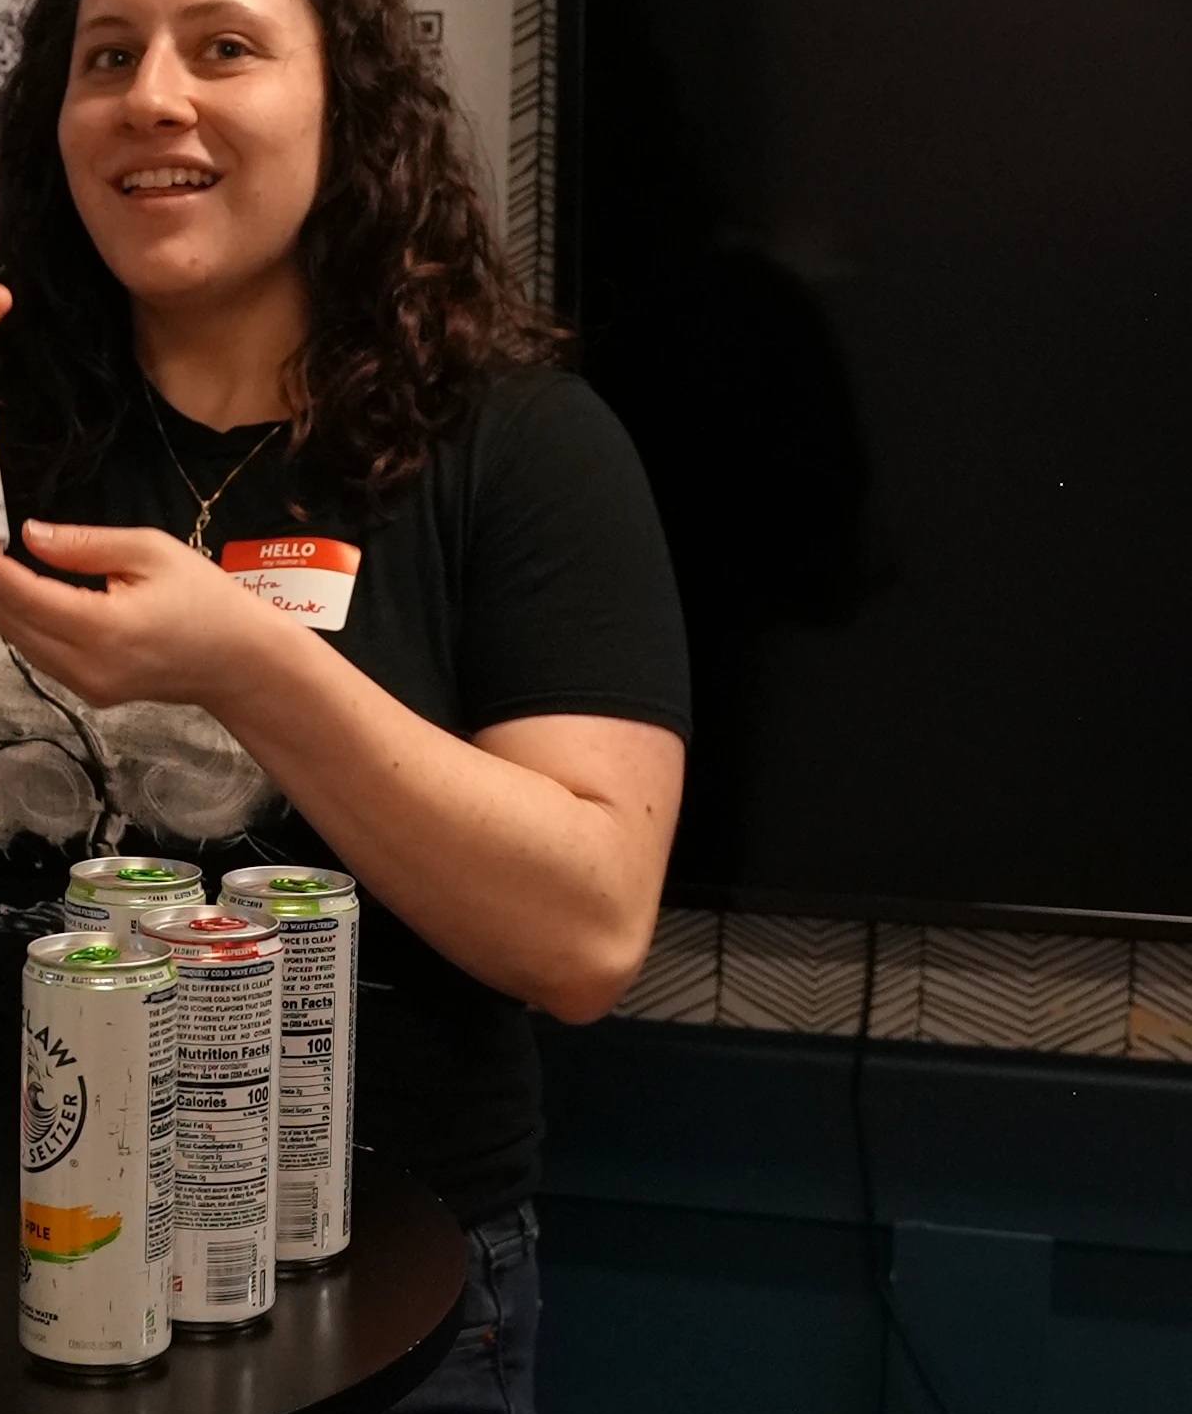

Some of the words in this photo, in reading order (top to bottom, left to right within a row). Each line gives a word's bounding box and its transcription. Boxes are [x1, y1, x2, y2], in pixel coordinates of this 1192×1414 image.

[260, 542, 316, 559] HELLO
[303, 936, 309, 944] IS
[192, 983, 241, 992] DIFFERENCE
[301, 996, 333, 1009] Facts
[229, 1013, 252, 1021] PICKED
[194, 1024, 217, 1032] WHITE
[219, 1023, 238, 1032] CLAW
[26, 1009, 77, 1068] LAW
[221, 1033, 236, 1041] LIKE
[178, 1047, 238, 1060] Nutrition
[242, 1044, 270, 1058] Facts
[307, 1038, 332, 1053] 100
[177, 1095, 227, 1107] Calories
[248, 1086, 269, 1104] 100
[29, 1094, 78, 1163] SELTZER
[35, 1308, 58, 1321] WATER
